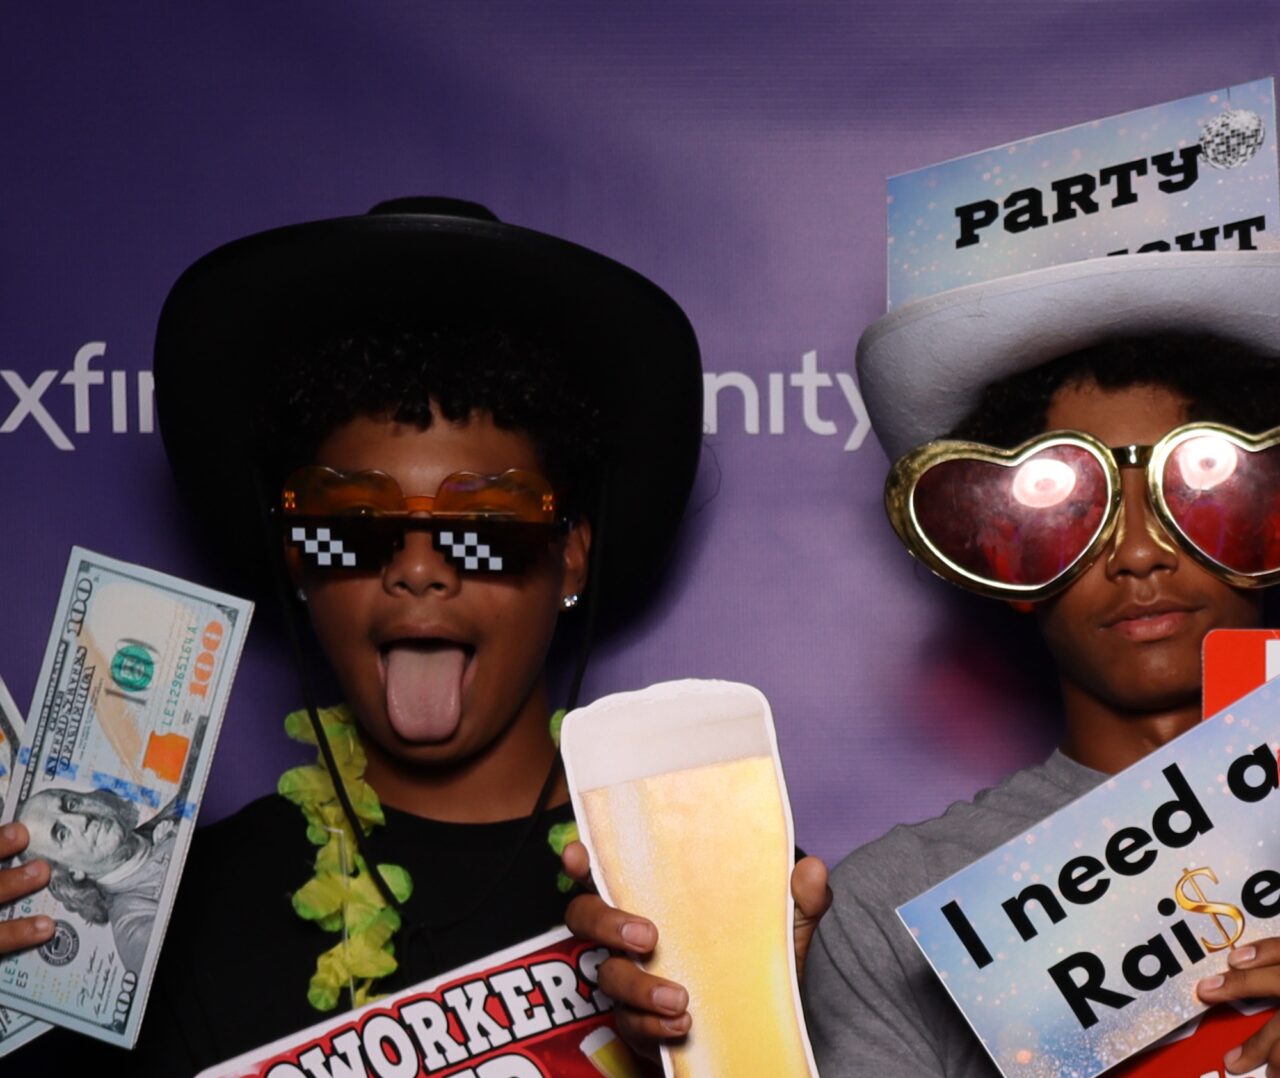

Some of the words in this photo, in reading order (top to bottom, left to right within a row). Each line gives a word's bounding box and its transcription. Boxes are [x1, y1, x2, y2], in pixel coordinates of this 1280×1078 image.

[67, 578, 93, 637] 100
[189, 620, 224, 699] 100
[941, 900, 993, 970] I
[1002, 762, 1214, 942] need
